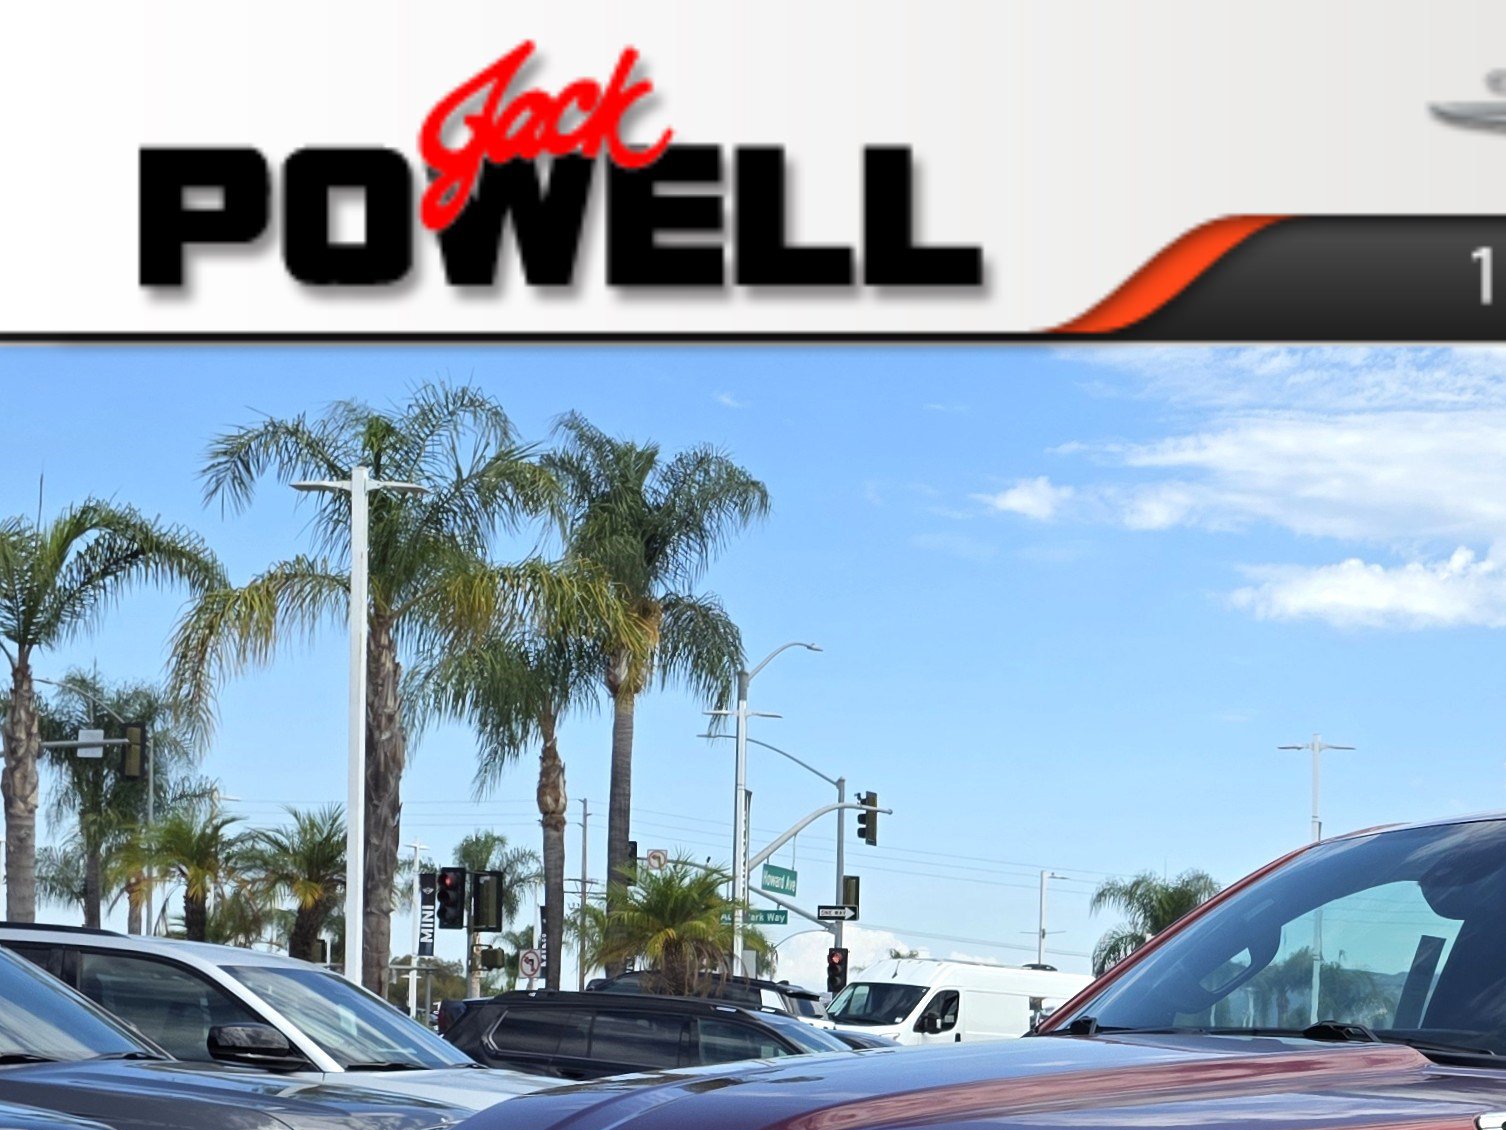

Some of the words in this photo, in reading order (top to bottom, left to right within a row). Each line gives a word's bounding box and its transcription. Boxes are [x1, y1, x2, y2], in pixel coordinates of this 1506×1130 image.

[763, 869, 785, 890] Howard
[420, 905, 435, 943] MINI
[767, 913, 786, 924] Way
